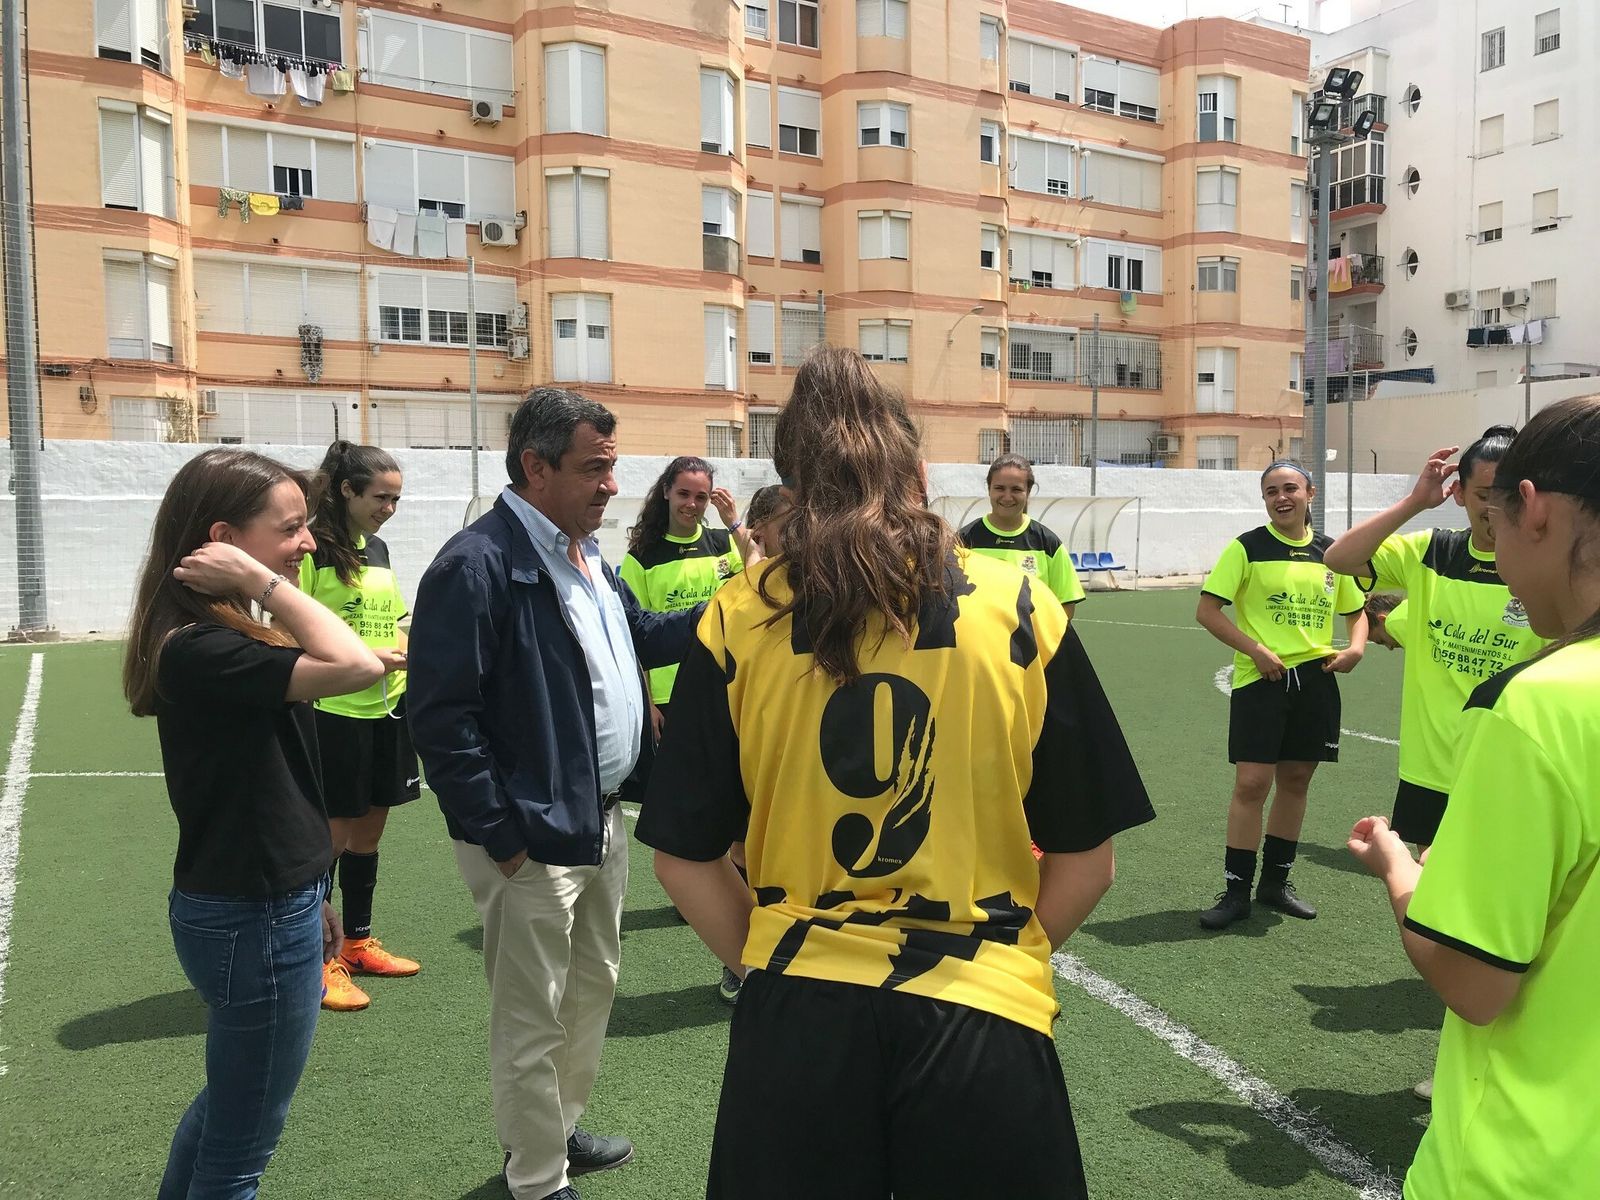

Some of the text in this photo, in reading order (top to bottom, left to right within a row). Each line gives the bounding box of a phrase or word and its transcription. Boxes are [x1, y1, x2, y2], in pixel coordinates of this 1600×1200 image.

[1469, 628, 1490, 644] del
[1491, 633, 1519, 650] Sur
[1456, 663, 1470, 674] 34
[1457, 653, 1470, 663] 88
[1471, 657, 1487, 667] 47
[1490, 659, 1504, 670] 72
[819, 672, 936, 878] 9
[877, 855, 902, 864] kromex
